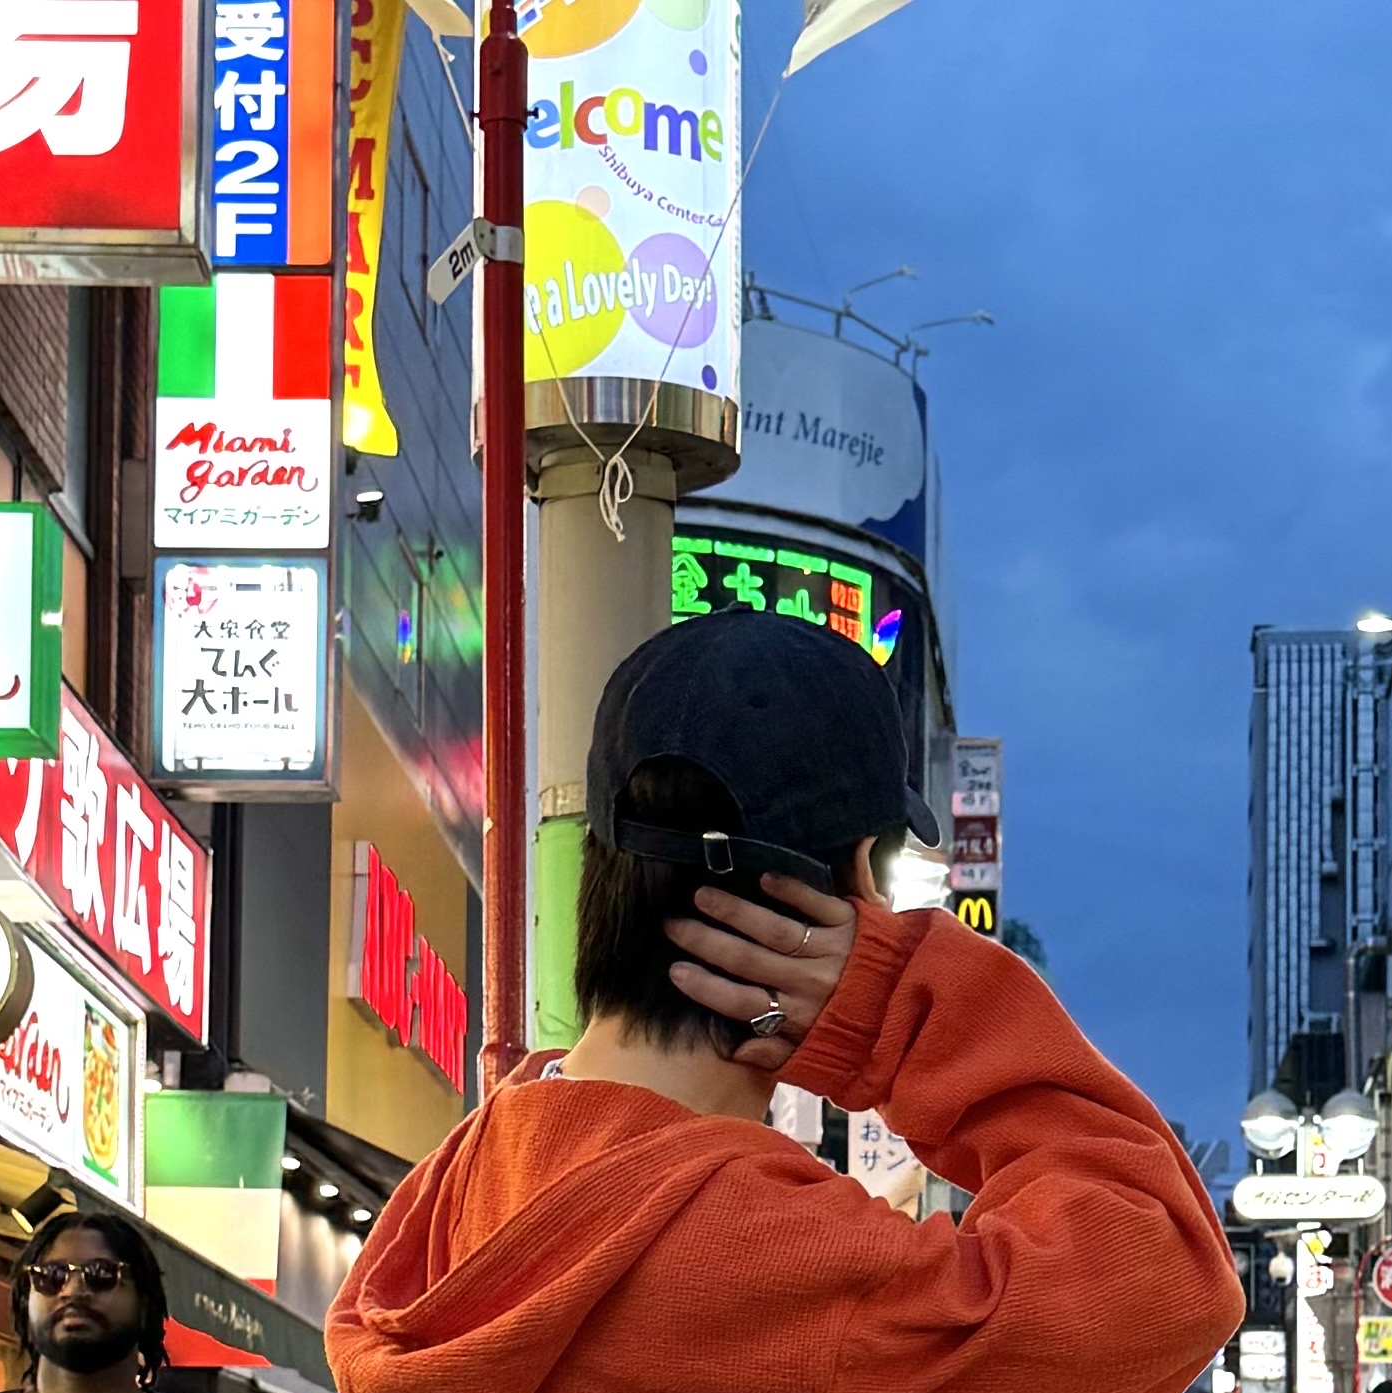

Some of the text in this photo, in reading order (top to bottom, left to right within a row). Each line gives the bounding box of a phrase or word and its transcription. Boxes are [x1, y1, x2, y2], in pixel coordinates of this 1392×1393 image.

[525, 80, 723, 162] elcome
[599, 145, 654, 202] Shibuya
[448, 241, 475, 281] 2m
[564, 258, 657, 318] Lovely
[663, 264, 713, 310] Day!
[165, 422, 297, 454] Miami
[793, 411, 885, 467] Marejie
[179, 459, 319, 504] garden
[164, 506, 321, 527] マイアミガーデン
[200, 646, 281, 679] てんぐ
[181, 678, 299, 716] 大ホール
